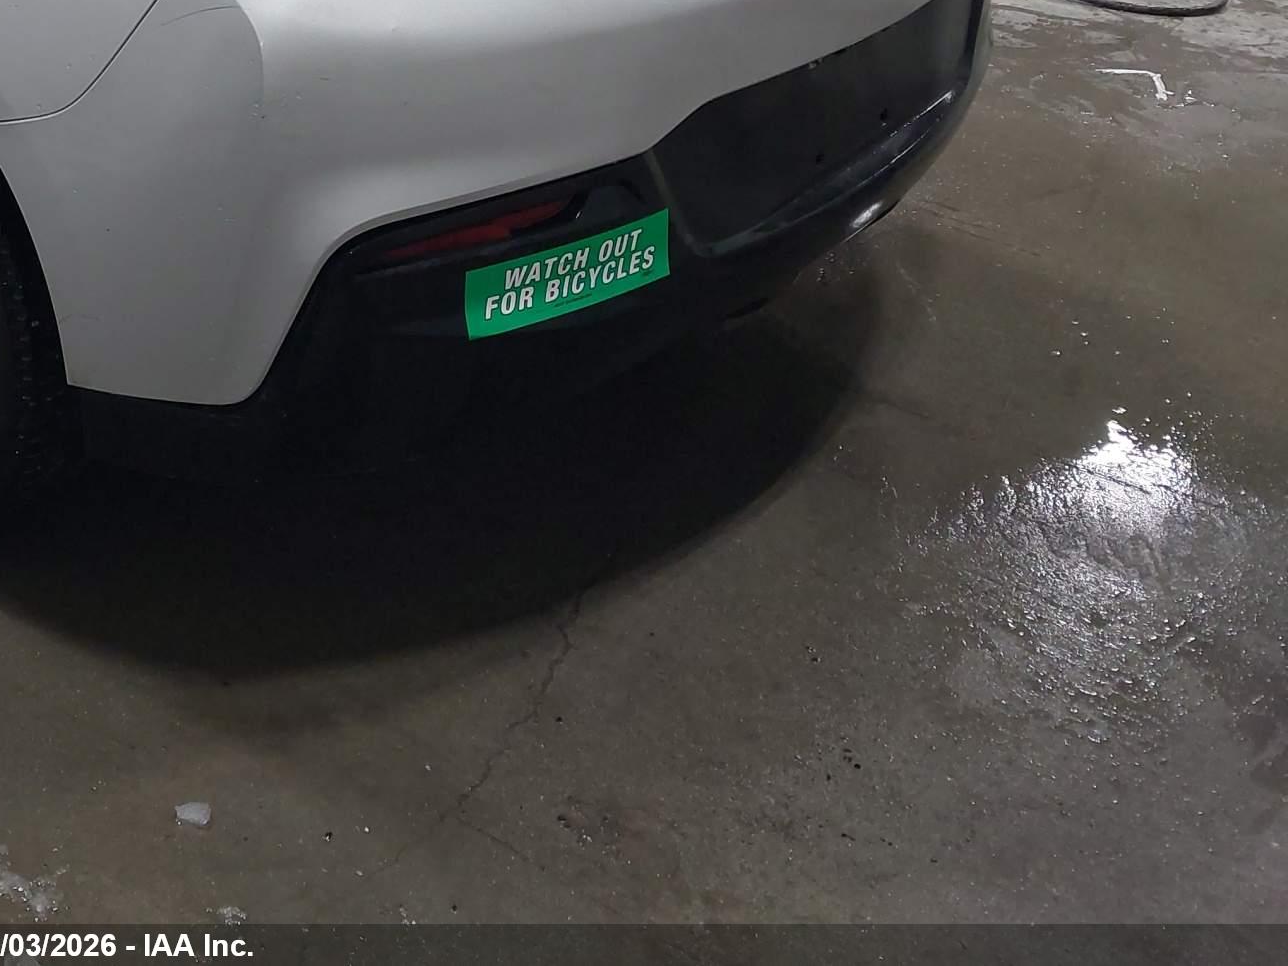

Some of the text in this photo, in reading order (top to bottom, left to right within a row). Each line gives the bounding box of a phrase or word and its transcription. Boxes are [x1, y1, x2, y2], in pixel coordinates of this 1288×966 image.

[485, 246, 655, 320] FOR BICYCLES
[505, 229, 642, 289] WATCH OUT
